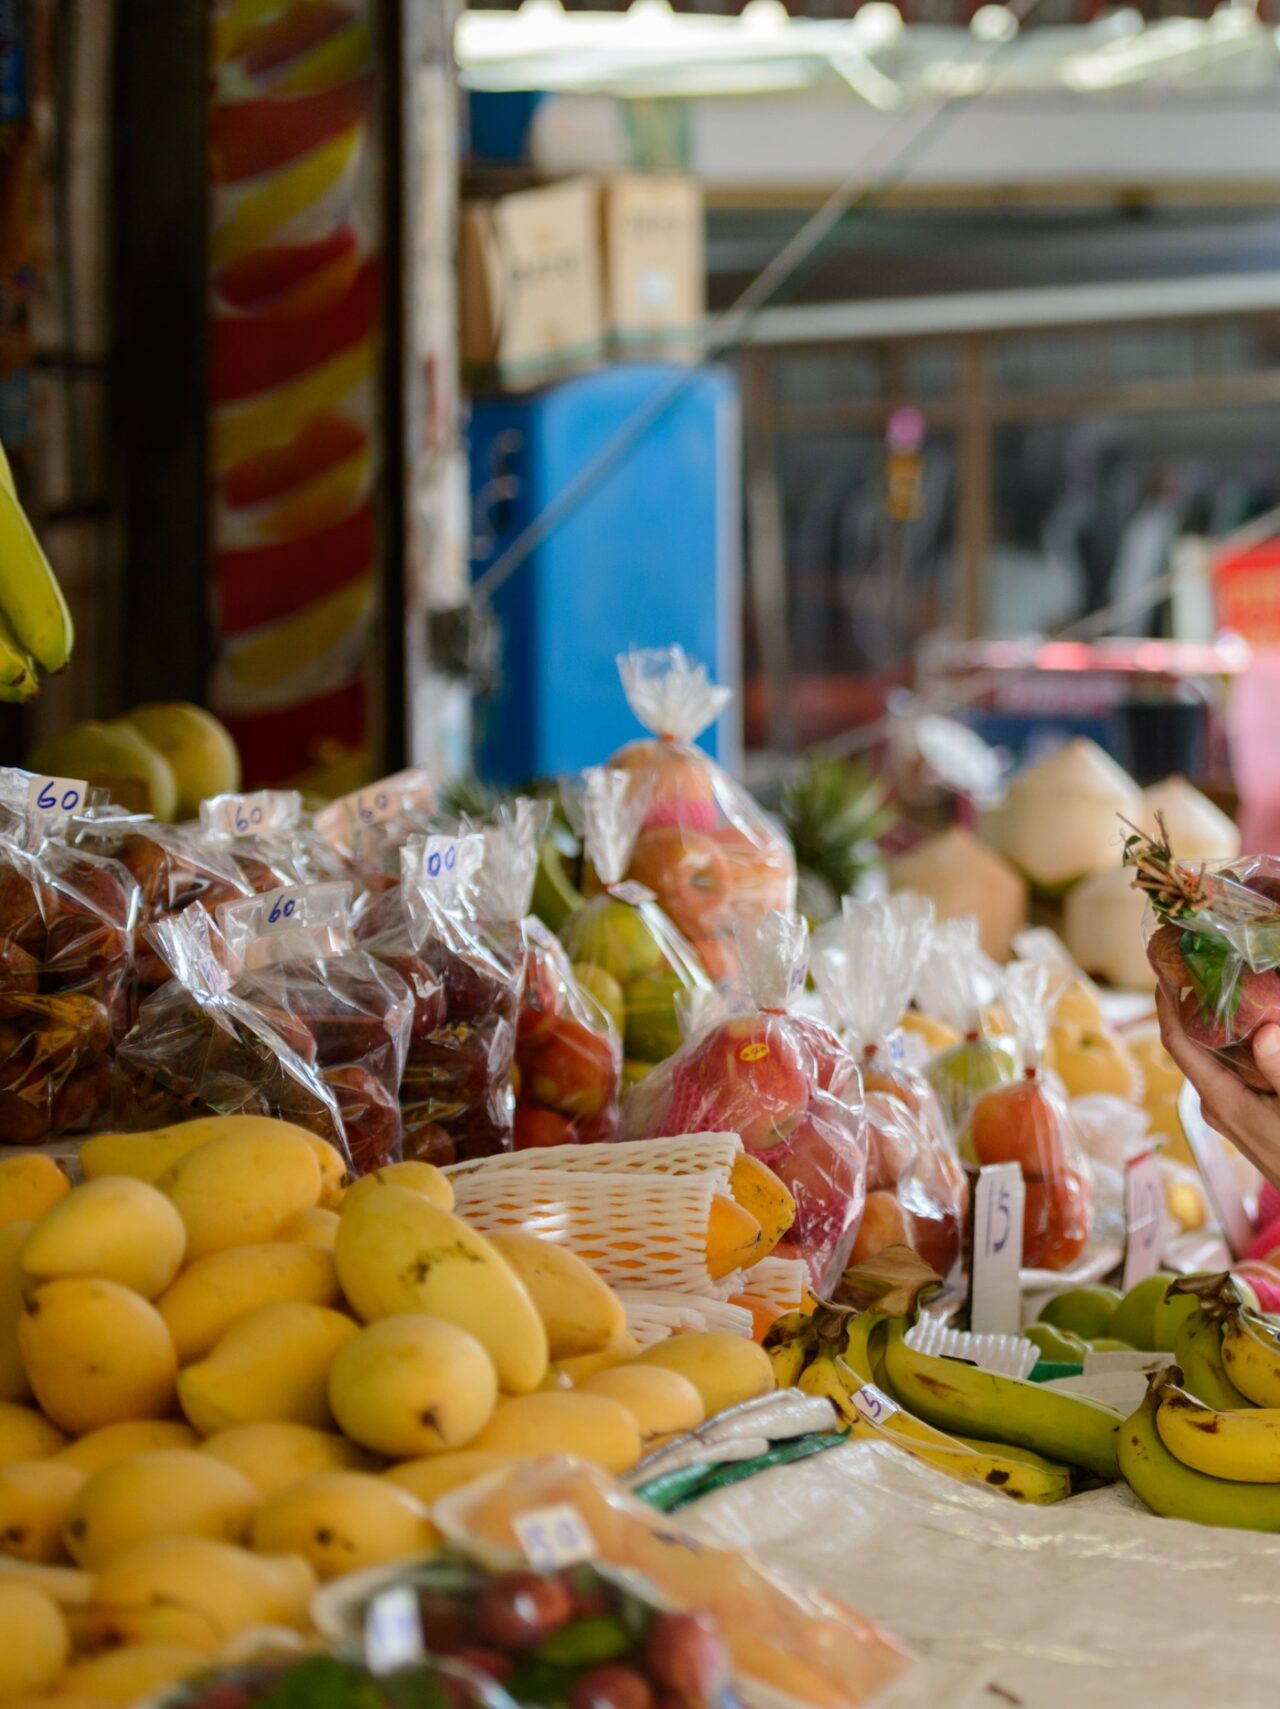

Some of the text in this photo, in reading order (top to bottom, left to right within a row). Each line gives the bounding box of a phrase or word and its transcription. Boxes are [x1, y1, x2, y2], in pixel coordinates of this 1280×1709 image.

[37, 780, 80, 811] 60
[358, 792, 389, 824] 60
[235, 805, 264, 832] 60
[268, 894, 296, 923] 60
[860, 1389, 882, 1418] 5
